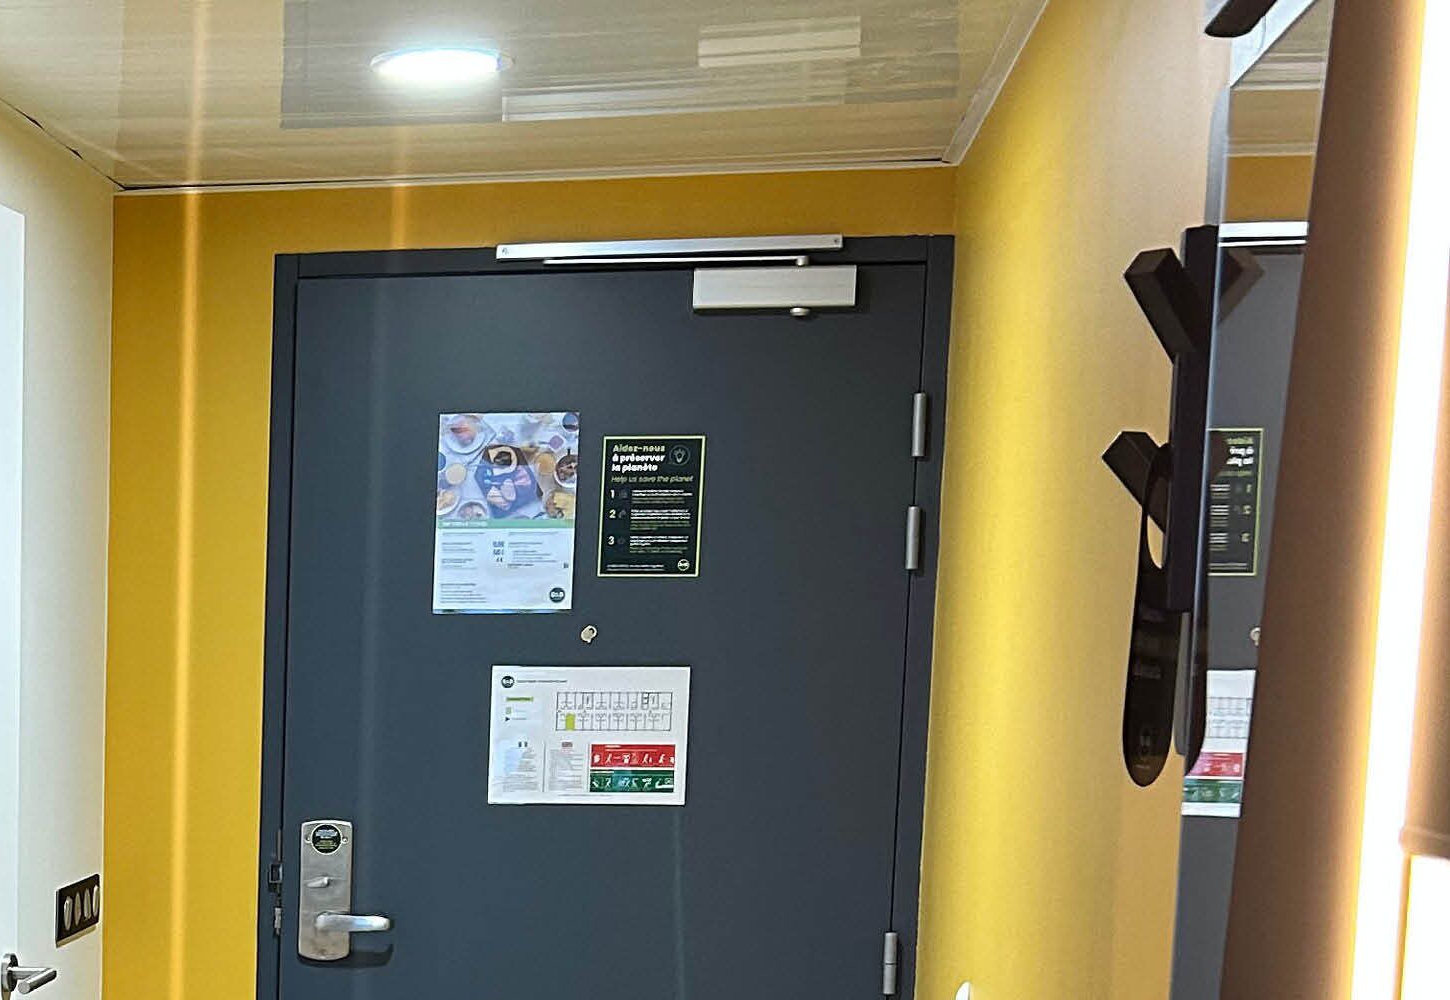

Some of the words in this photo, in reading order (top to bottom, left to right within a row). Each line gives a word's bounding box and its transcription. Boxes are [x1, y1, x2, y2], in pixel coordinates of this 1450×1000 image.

[613, 443, 665, 452] Aidez-nous
[612, 453, 619, 462] à
[620, 453, 666, 463] préserver
[611, 463, 621, 471] la
[621, 463, 658, 473] planète
[611, 475, 628, 484] Help
[656, 475, 669, 483] the
[670, 475, 694, 483] planet
[610, 489, 615, 499] 1
[609, 509, 616, 519] 2
[608, 536, 615, 545] 3
